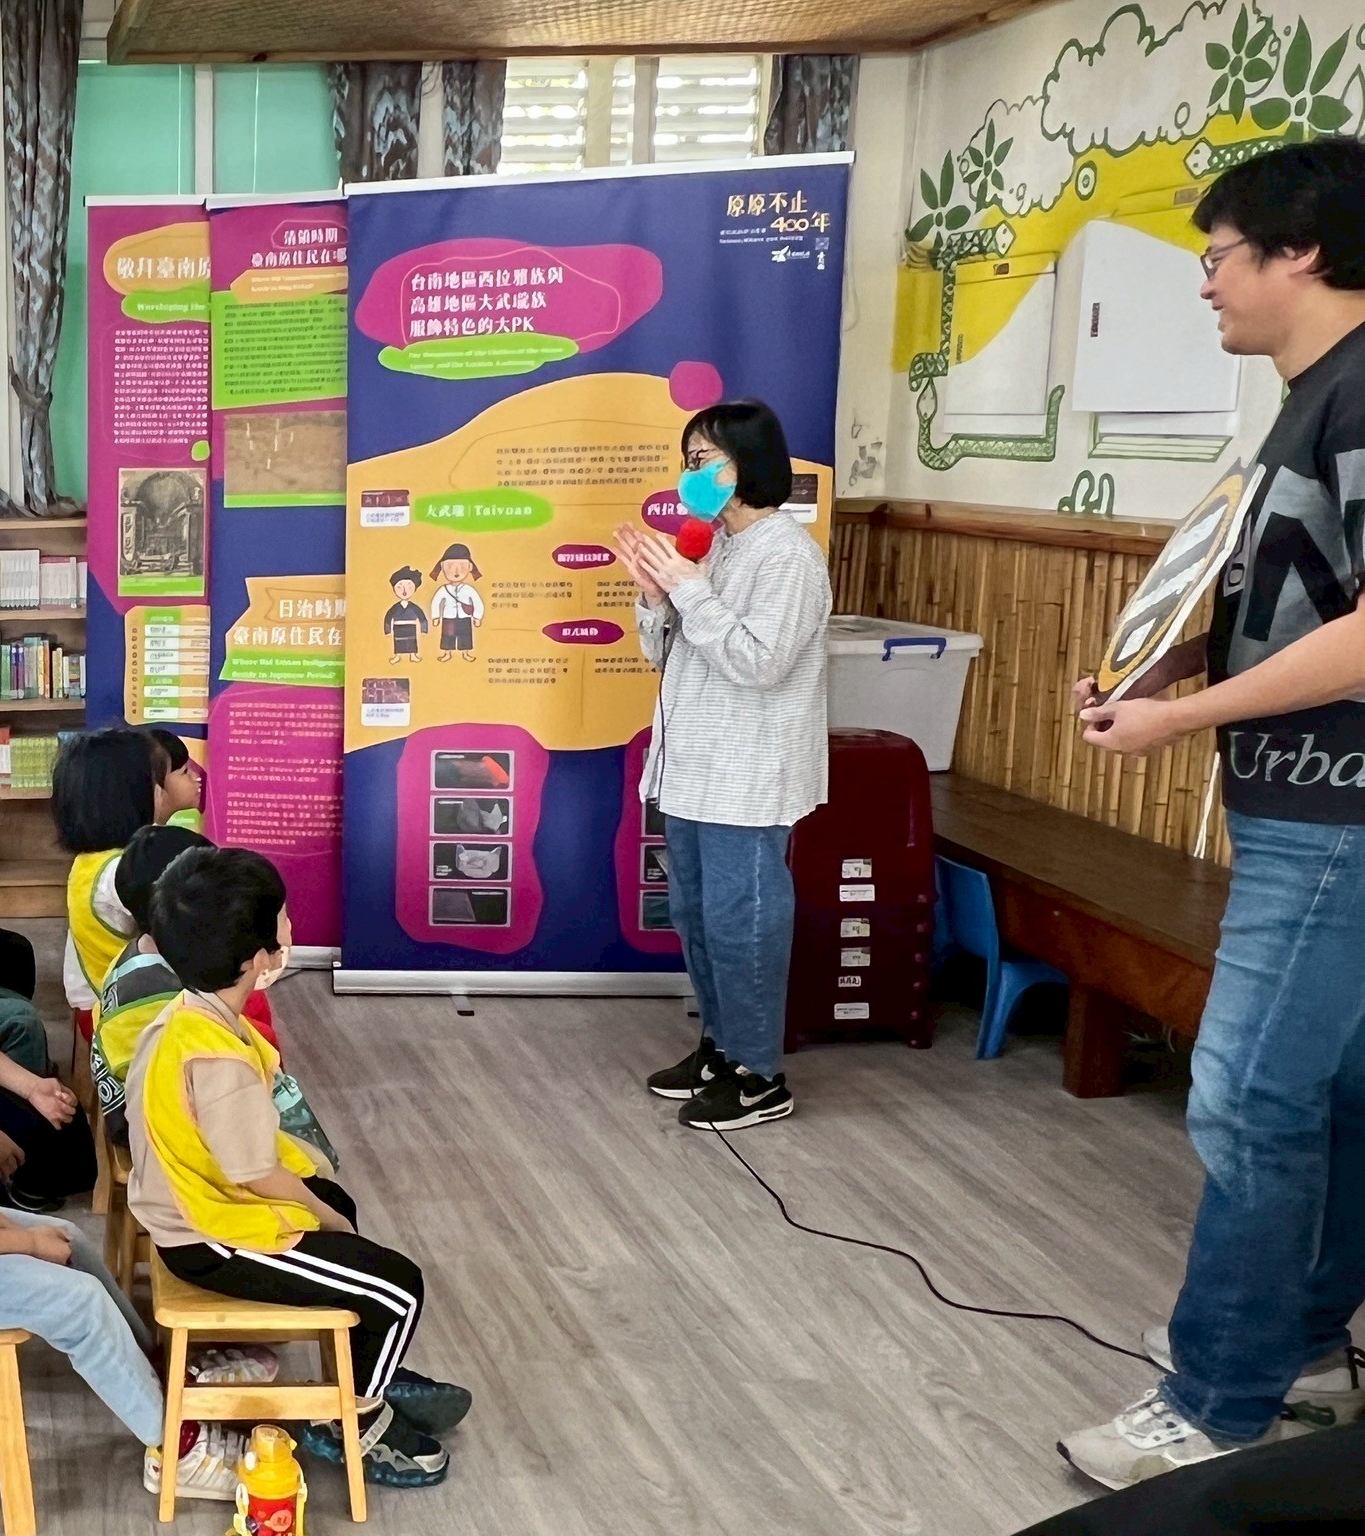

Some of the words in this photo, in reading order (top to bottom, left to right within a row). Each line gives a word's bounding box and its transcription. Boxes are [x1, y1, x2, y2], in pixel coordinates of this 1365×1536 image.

[726, 189, 808, 217] 原原不止
[770, 211, 831, 233] 400年
[410, 265, 564, 292] 台南地區西拉雅族與
